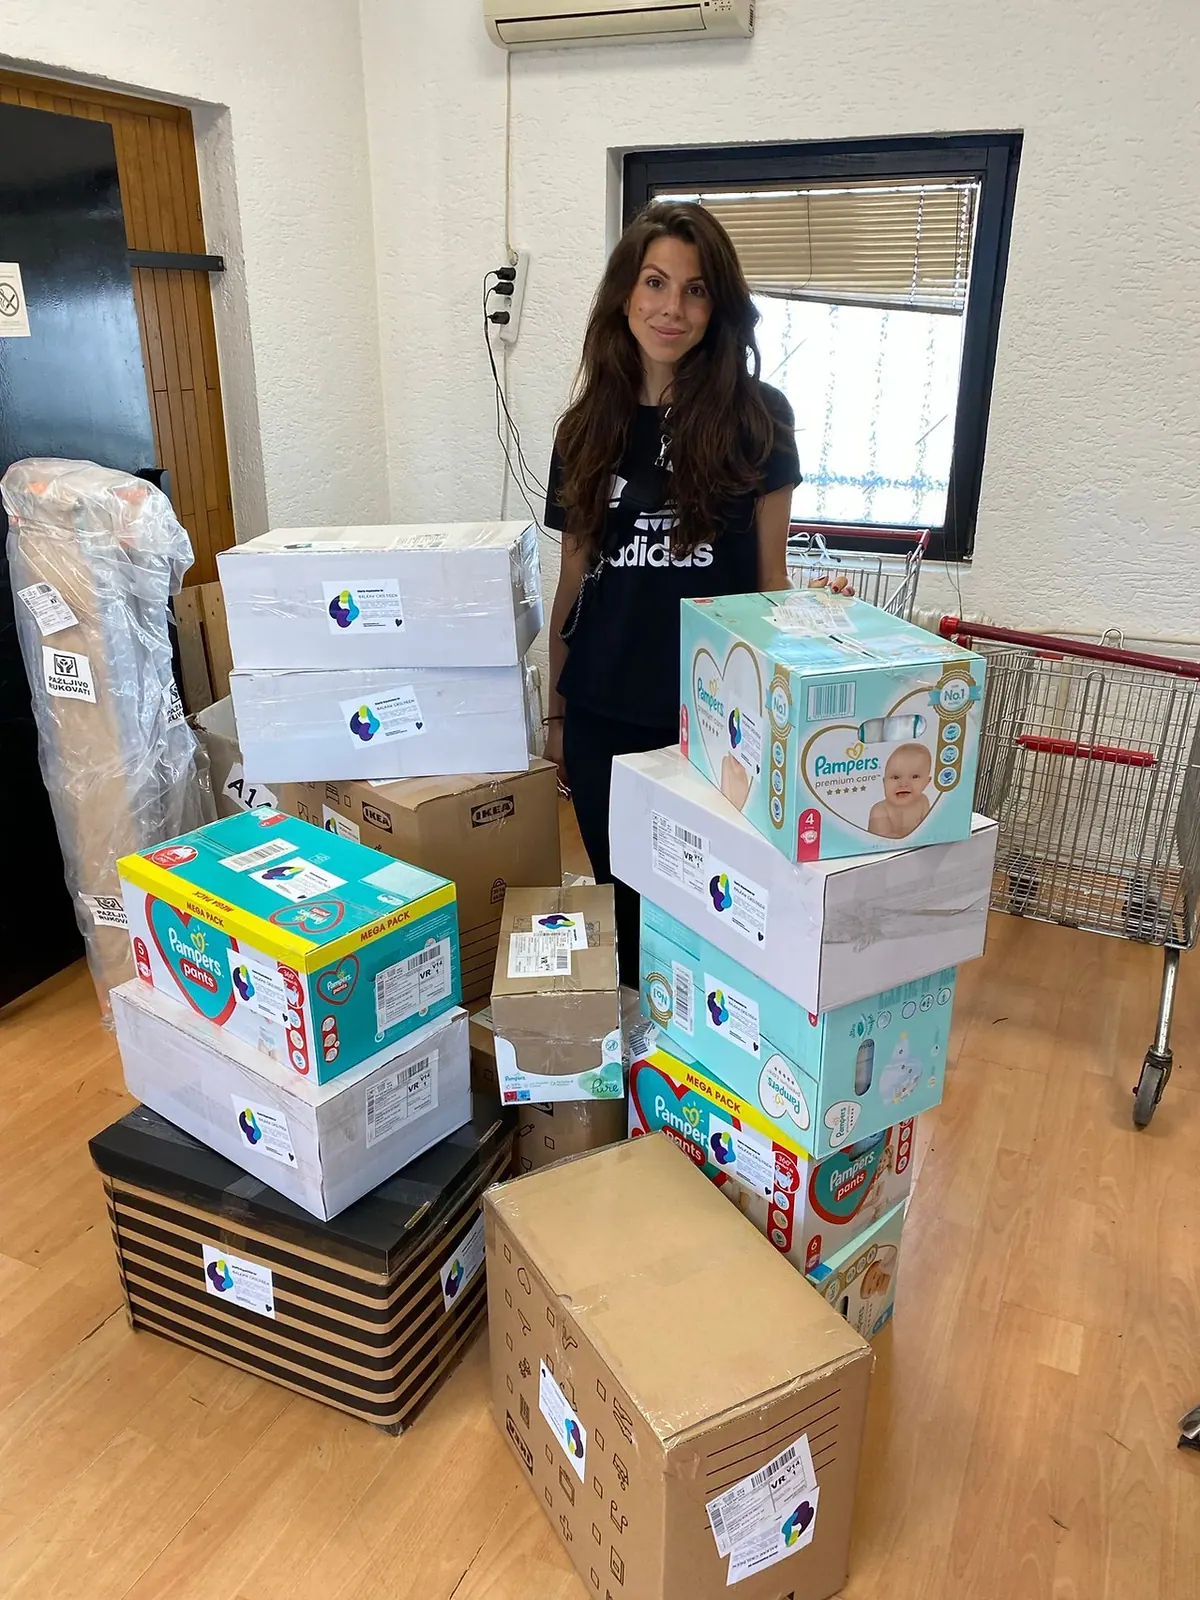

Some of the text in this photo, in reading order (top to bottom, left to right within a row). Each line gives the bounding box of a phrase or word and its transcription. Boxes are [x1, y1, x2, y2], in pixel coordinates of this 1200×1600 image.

[697, 677, 724, 717] Pampers
[944, 689, 965, 701] No.1
[815, 755, 879, 777] Pampers
[227, 778, 273, 808] A1
[815, 776, 854, 789] premium
[365, 807, 390, 827] IKEA
[475, 803, 511, 820] IKEA
[805, 813, 815, 825] 4
[683, 850, 694, 862] VR
[186, 901, 225, 928] MEGA PACK
[360, 922, 386, 942] MEGA
[386, 910, 411, 927] PACK
[137, 942, 145, 956] 5
[168, 926, 222, 977] Pampers
[183, 963, 215, 988] pants
[419, 969, 432, 980] VR
[408, 1081, 420, 1093] VR
[590, 1078, 619, 1093] Pure
[685, 1072, 742, 1115] MEGA PACK
[767, 1077, 801, 1114] Pampers
[835, 1107, 847, 1138] Pampers
[829, 1151, 875, 1191] Pampers
[837, 1172, 865, 1200] pants
[811, 1240, 818, 1250] 6
[771, 1460, 801, 1489] VR V14
